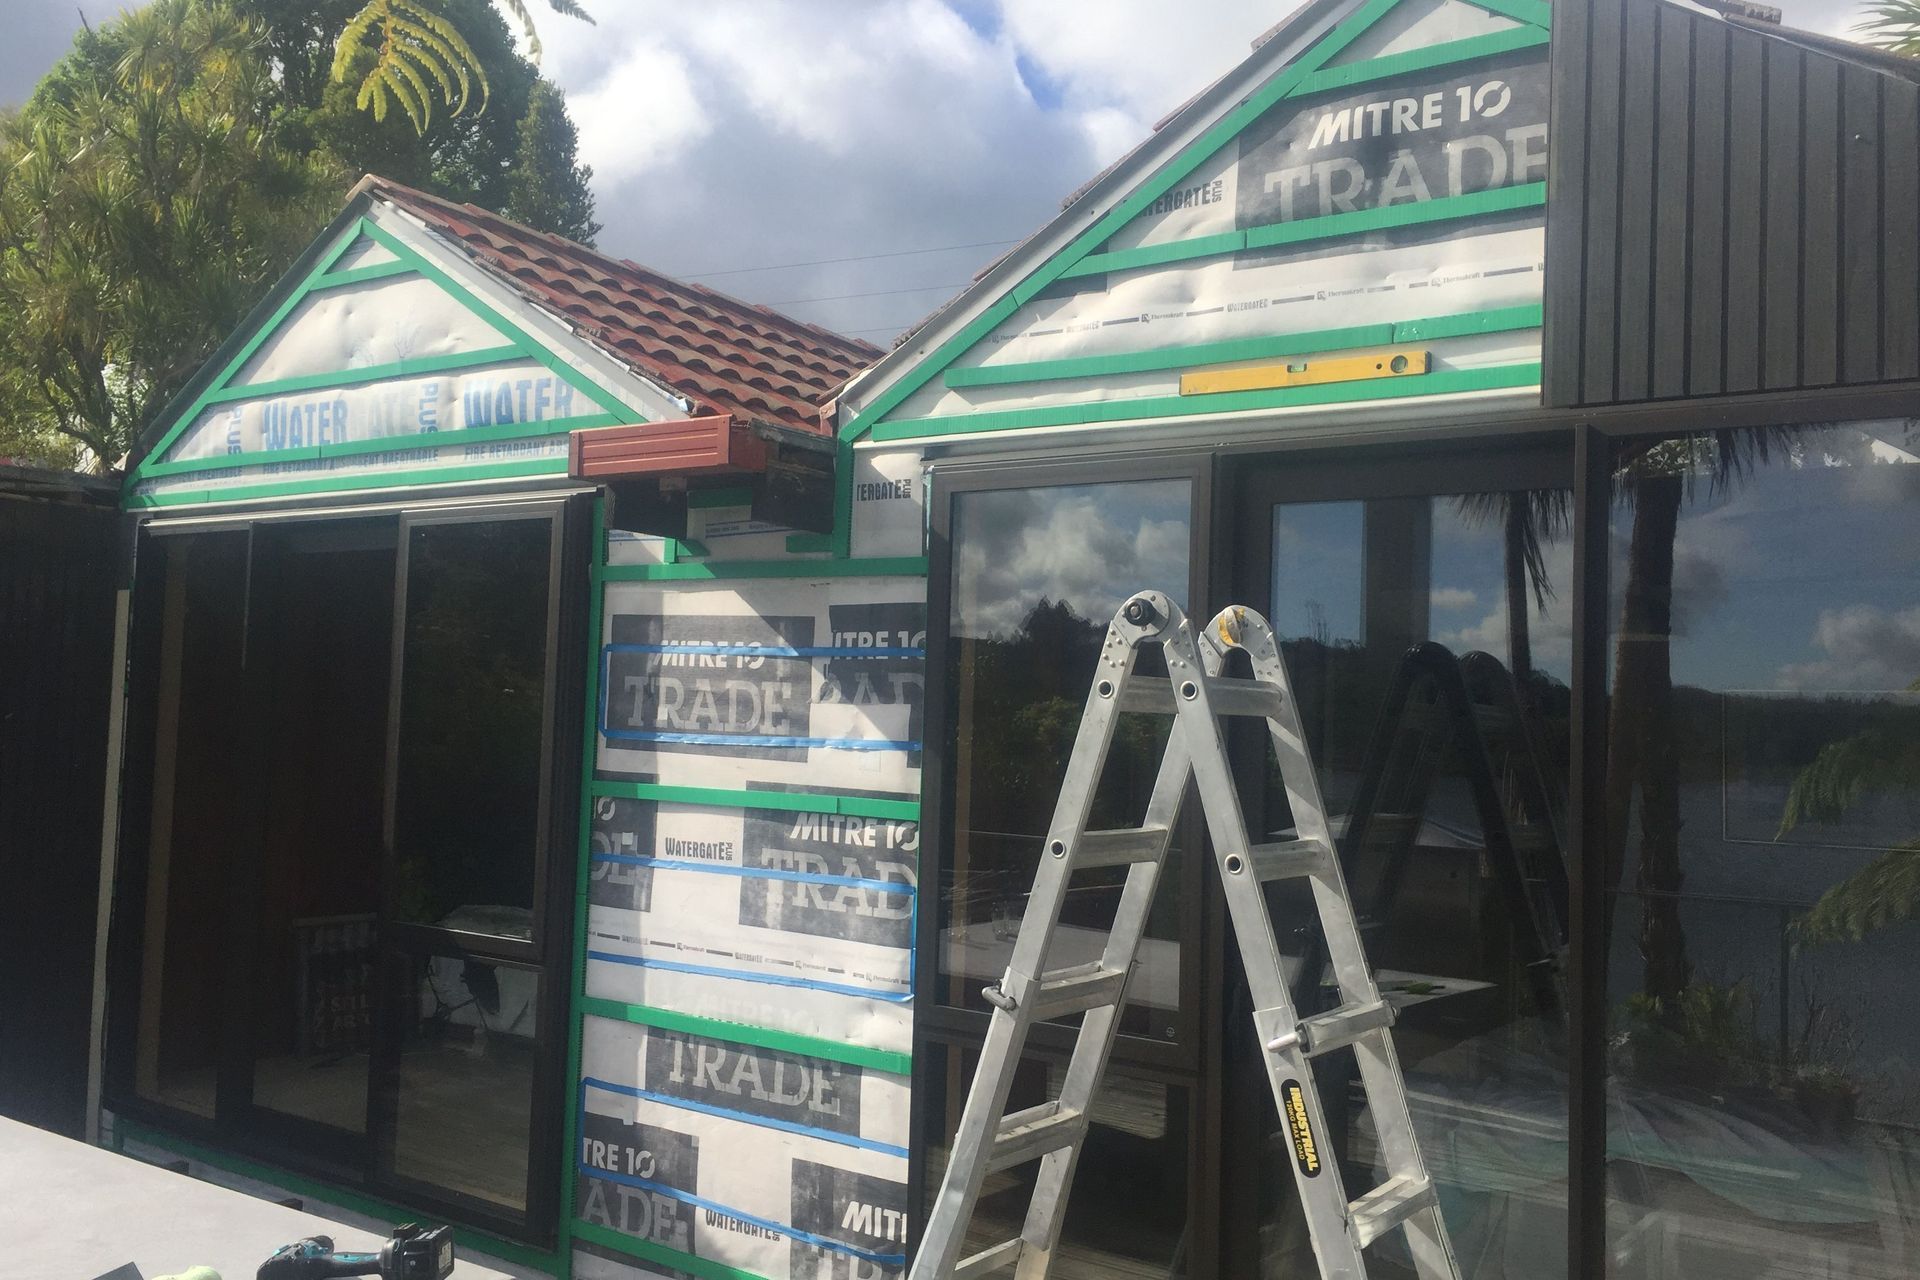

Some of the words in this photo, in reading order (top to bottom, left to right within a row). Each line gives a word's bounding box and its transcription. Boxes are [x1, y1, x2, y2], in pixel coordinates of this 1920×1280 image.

[1308, 92, 1443, 149] MITRE
[1456, 81, 1511, 121] 10
[1212, 180, 1222, 203] PLUS
[903, 479, 911, 499] PLUS
[652, 640, 728, 668] MITRE
[734, 641, 765, 669] 10
[624, 676, 792, 735] TRADE
[665, 837, 724, 861] WATERGATE
[790, 812, 875, 847] MITRE
[887, 821, 919, 851] 10
[761, 848, 917, 920] TRAD
[664, 1031, 840, 1116] TRADE
[1290, 1087, 1318, 1171] INDUSTRIAL
[583, 1137, 619, 1171] TRE
[626, 1147, 655, 1178] 10
[1296, 1140, 1305, 1160] LOAD
